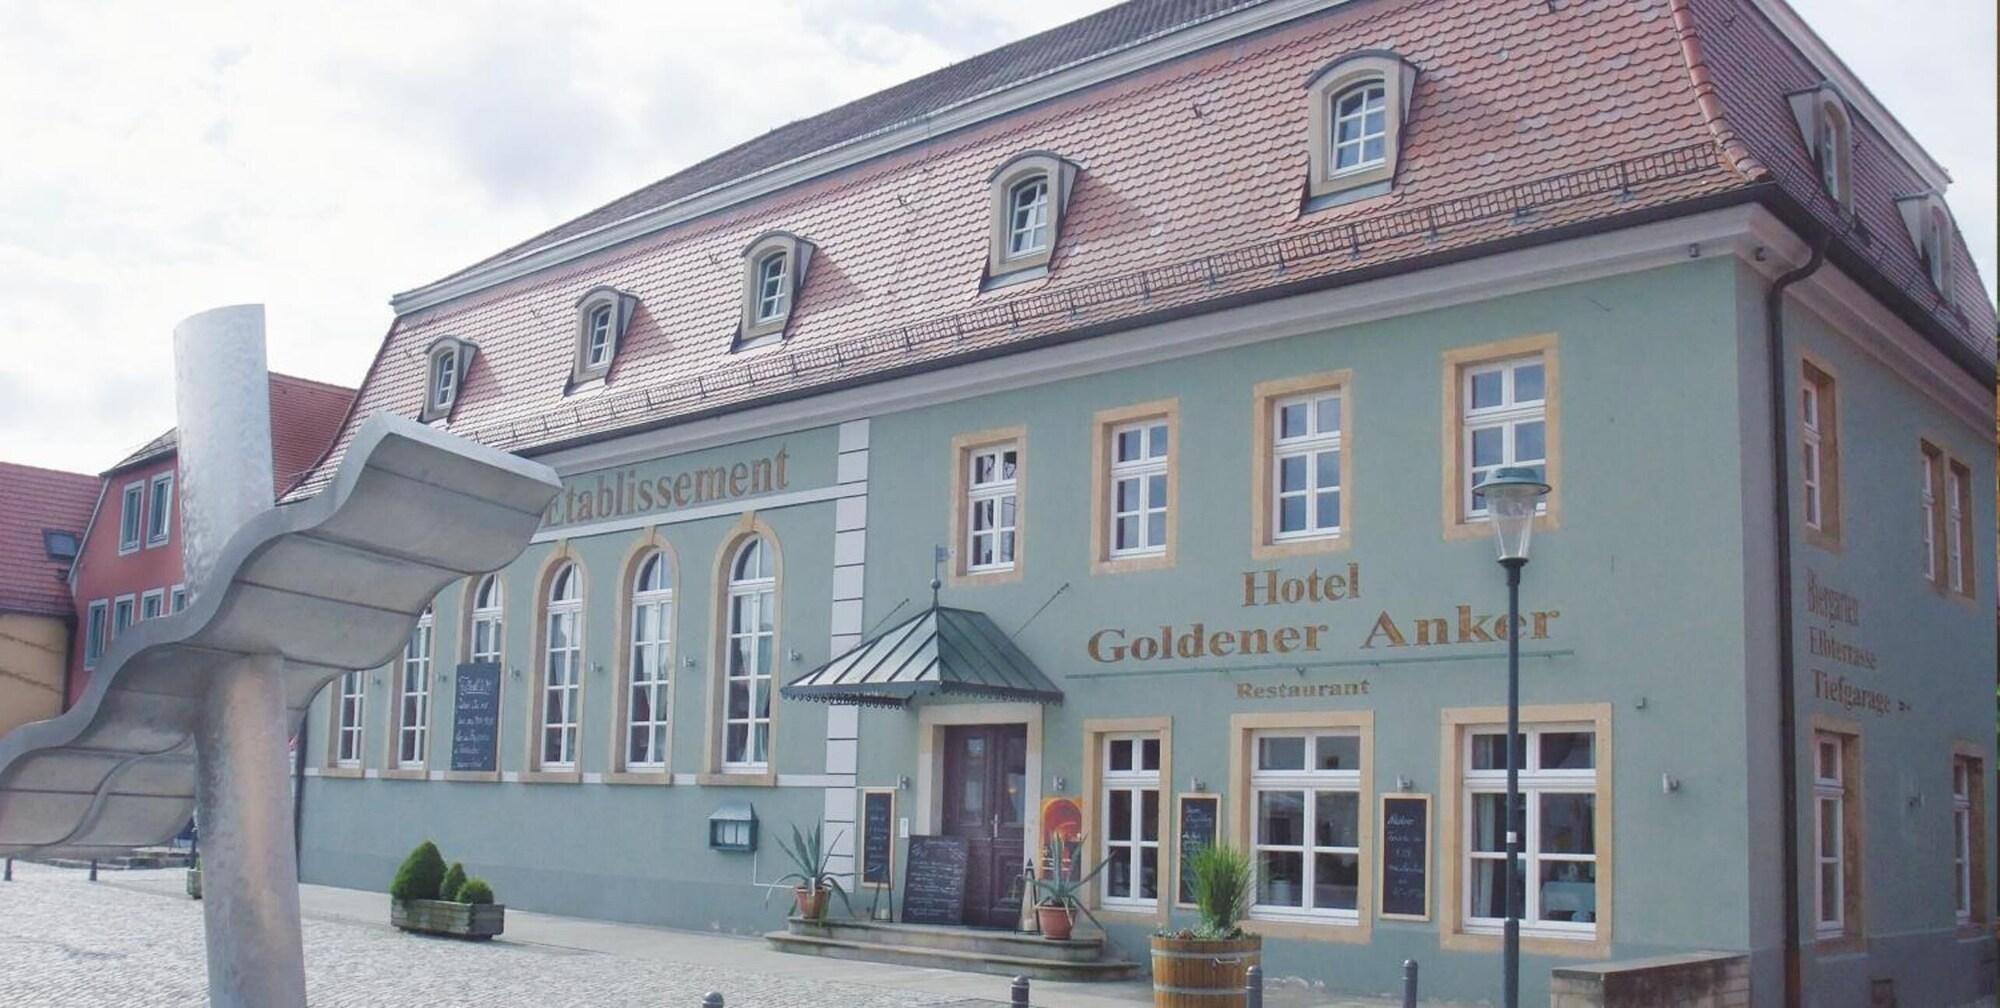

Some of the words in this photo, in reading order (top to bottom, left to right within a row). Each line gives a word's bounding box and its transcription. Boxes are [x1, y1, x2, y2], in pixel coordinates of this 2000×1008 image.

[542, 441, 791, 528] Etablissement
[1240, 561, 1361, 608] Hotel
[1087, 622, 1330, 664] Goldener
[1359, 604, 1561, 650] Anker
[1236, 679, 1371, 700] Restaurant
[1810, 668, 1891, 718] Tiefgarage
